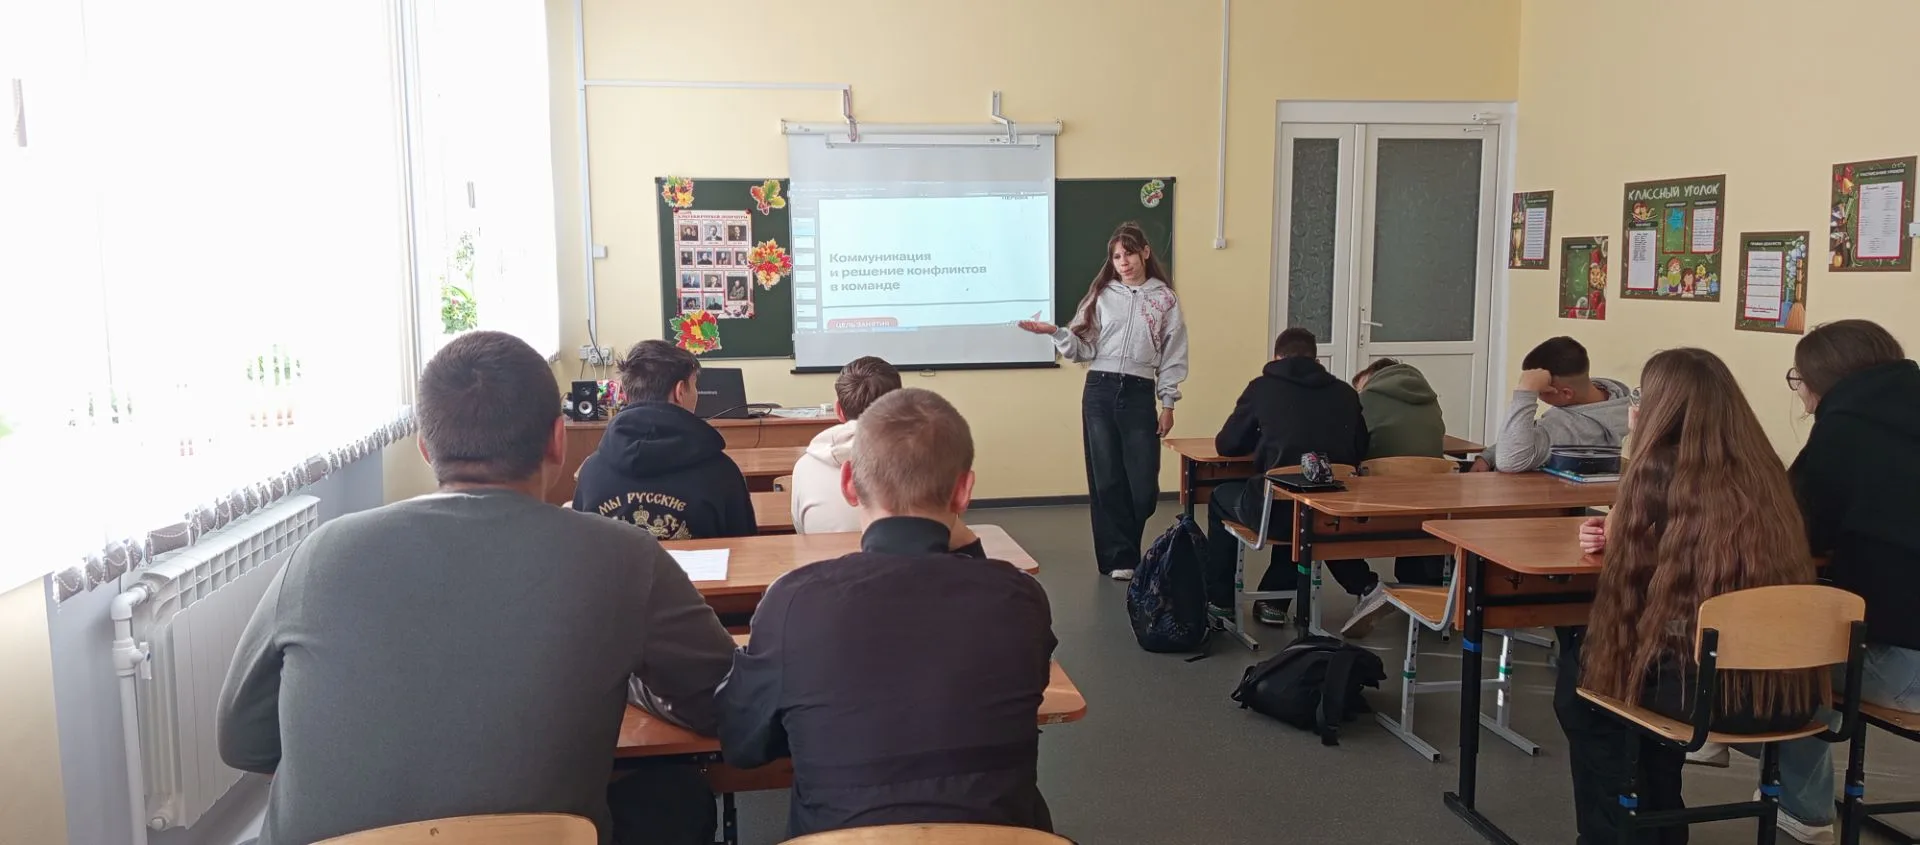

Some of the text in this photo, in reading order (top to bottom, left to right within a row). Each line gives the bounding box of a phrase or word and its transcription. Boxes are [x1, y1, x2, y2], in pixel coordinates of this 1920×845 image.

[1628, 182, 1720, 201] КЛАССНЫЙ УГОЛОК
[829, 252, 932, 264] Коммуникация
[830, 265, 987, 279] и решение конфликтов
[830, 281, 901, 292] в команде
[598, 492, 687, 515] МЫ РУССКИЕ
